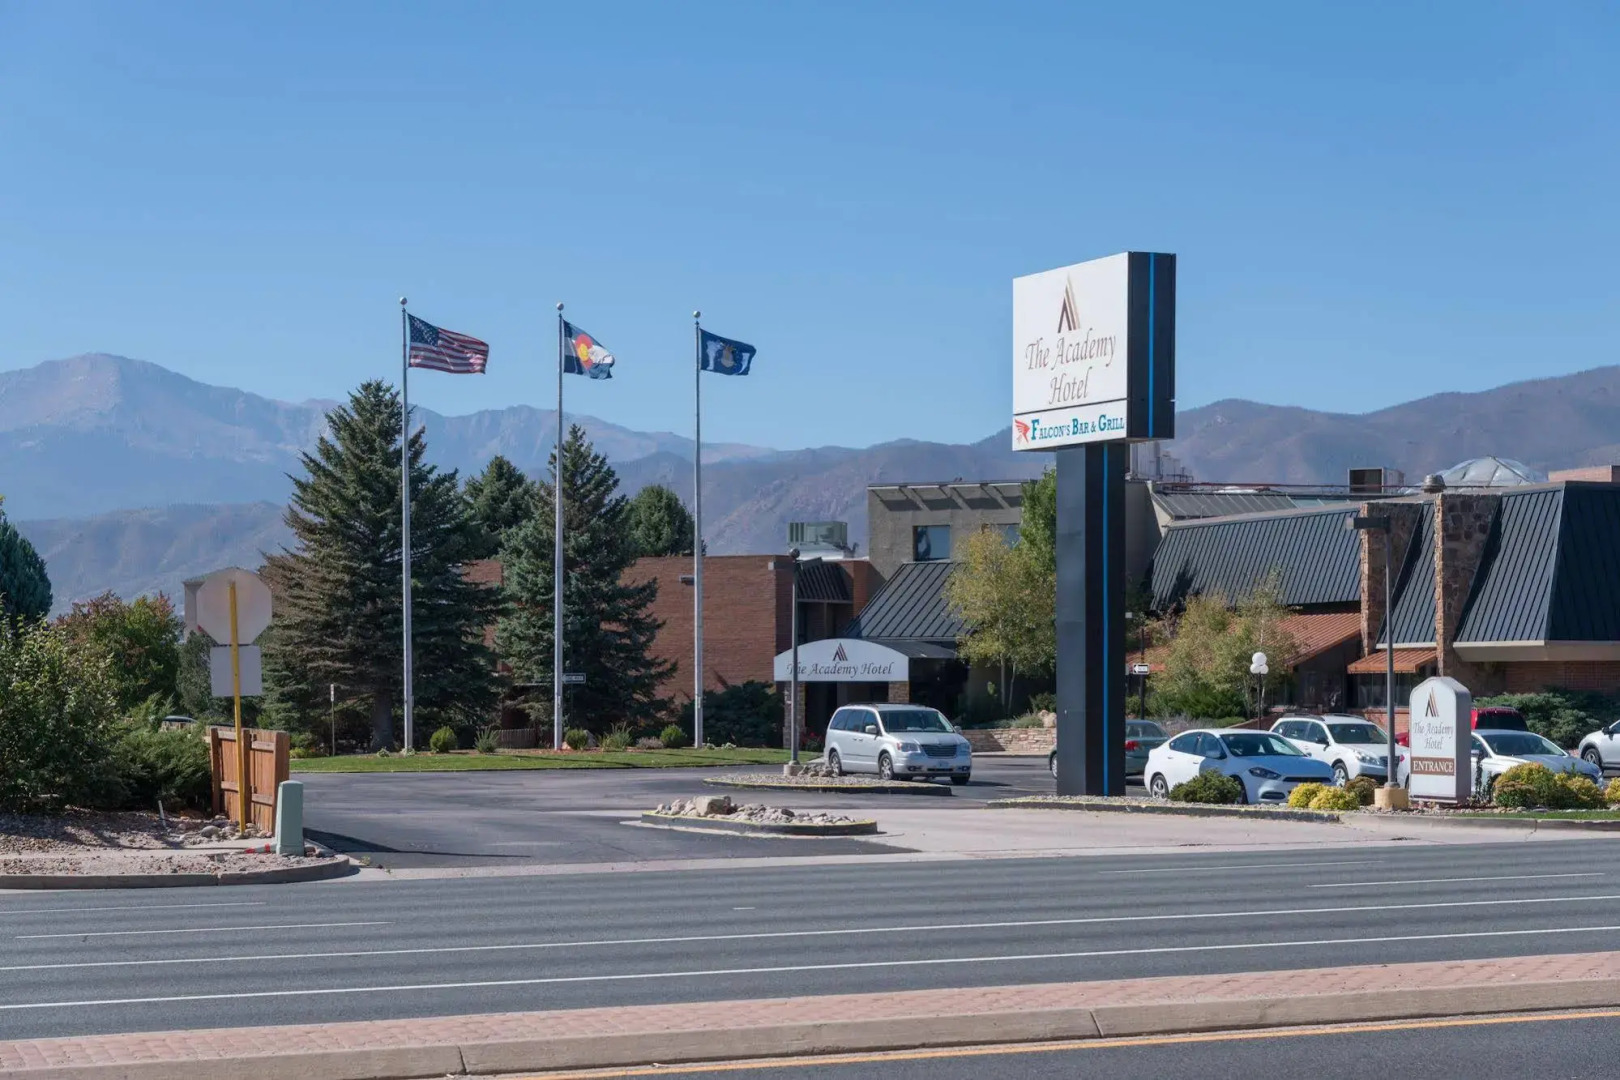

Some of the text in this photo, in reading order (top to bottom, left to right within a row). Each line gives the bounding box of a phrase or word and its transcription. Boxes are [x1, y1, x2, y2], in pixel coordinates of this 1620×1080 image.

[1025, 328, 1116, 371] The Academy
[1049, 367, 1093, 405] Hotel
[1090, 421, 1096, 433] &
[808, 661, 858, 678] Academy
[860, 661, 895, 675] Hotel
[1413, 721, 1454, 739] The Academy
[1424, 736, 1444, 750] Hotel
[1413, 760, 1454, 773] ENTRANCE
